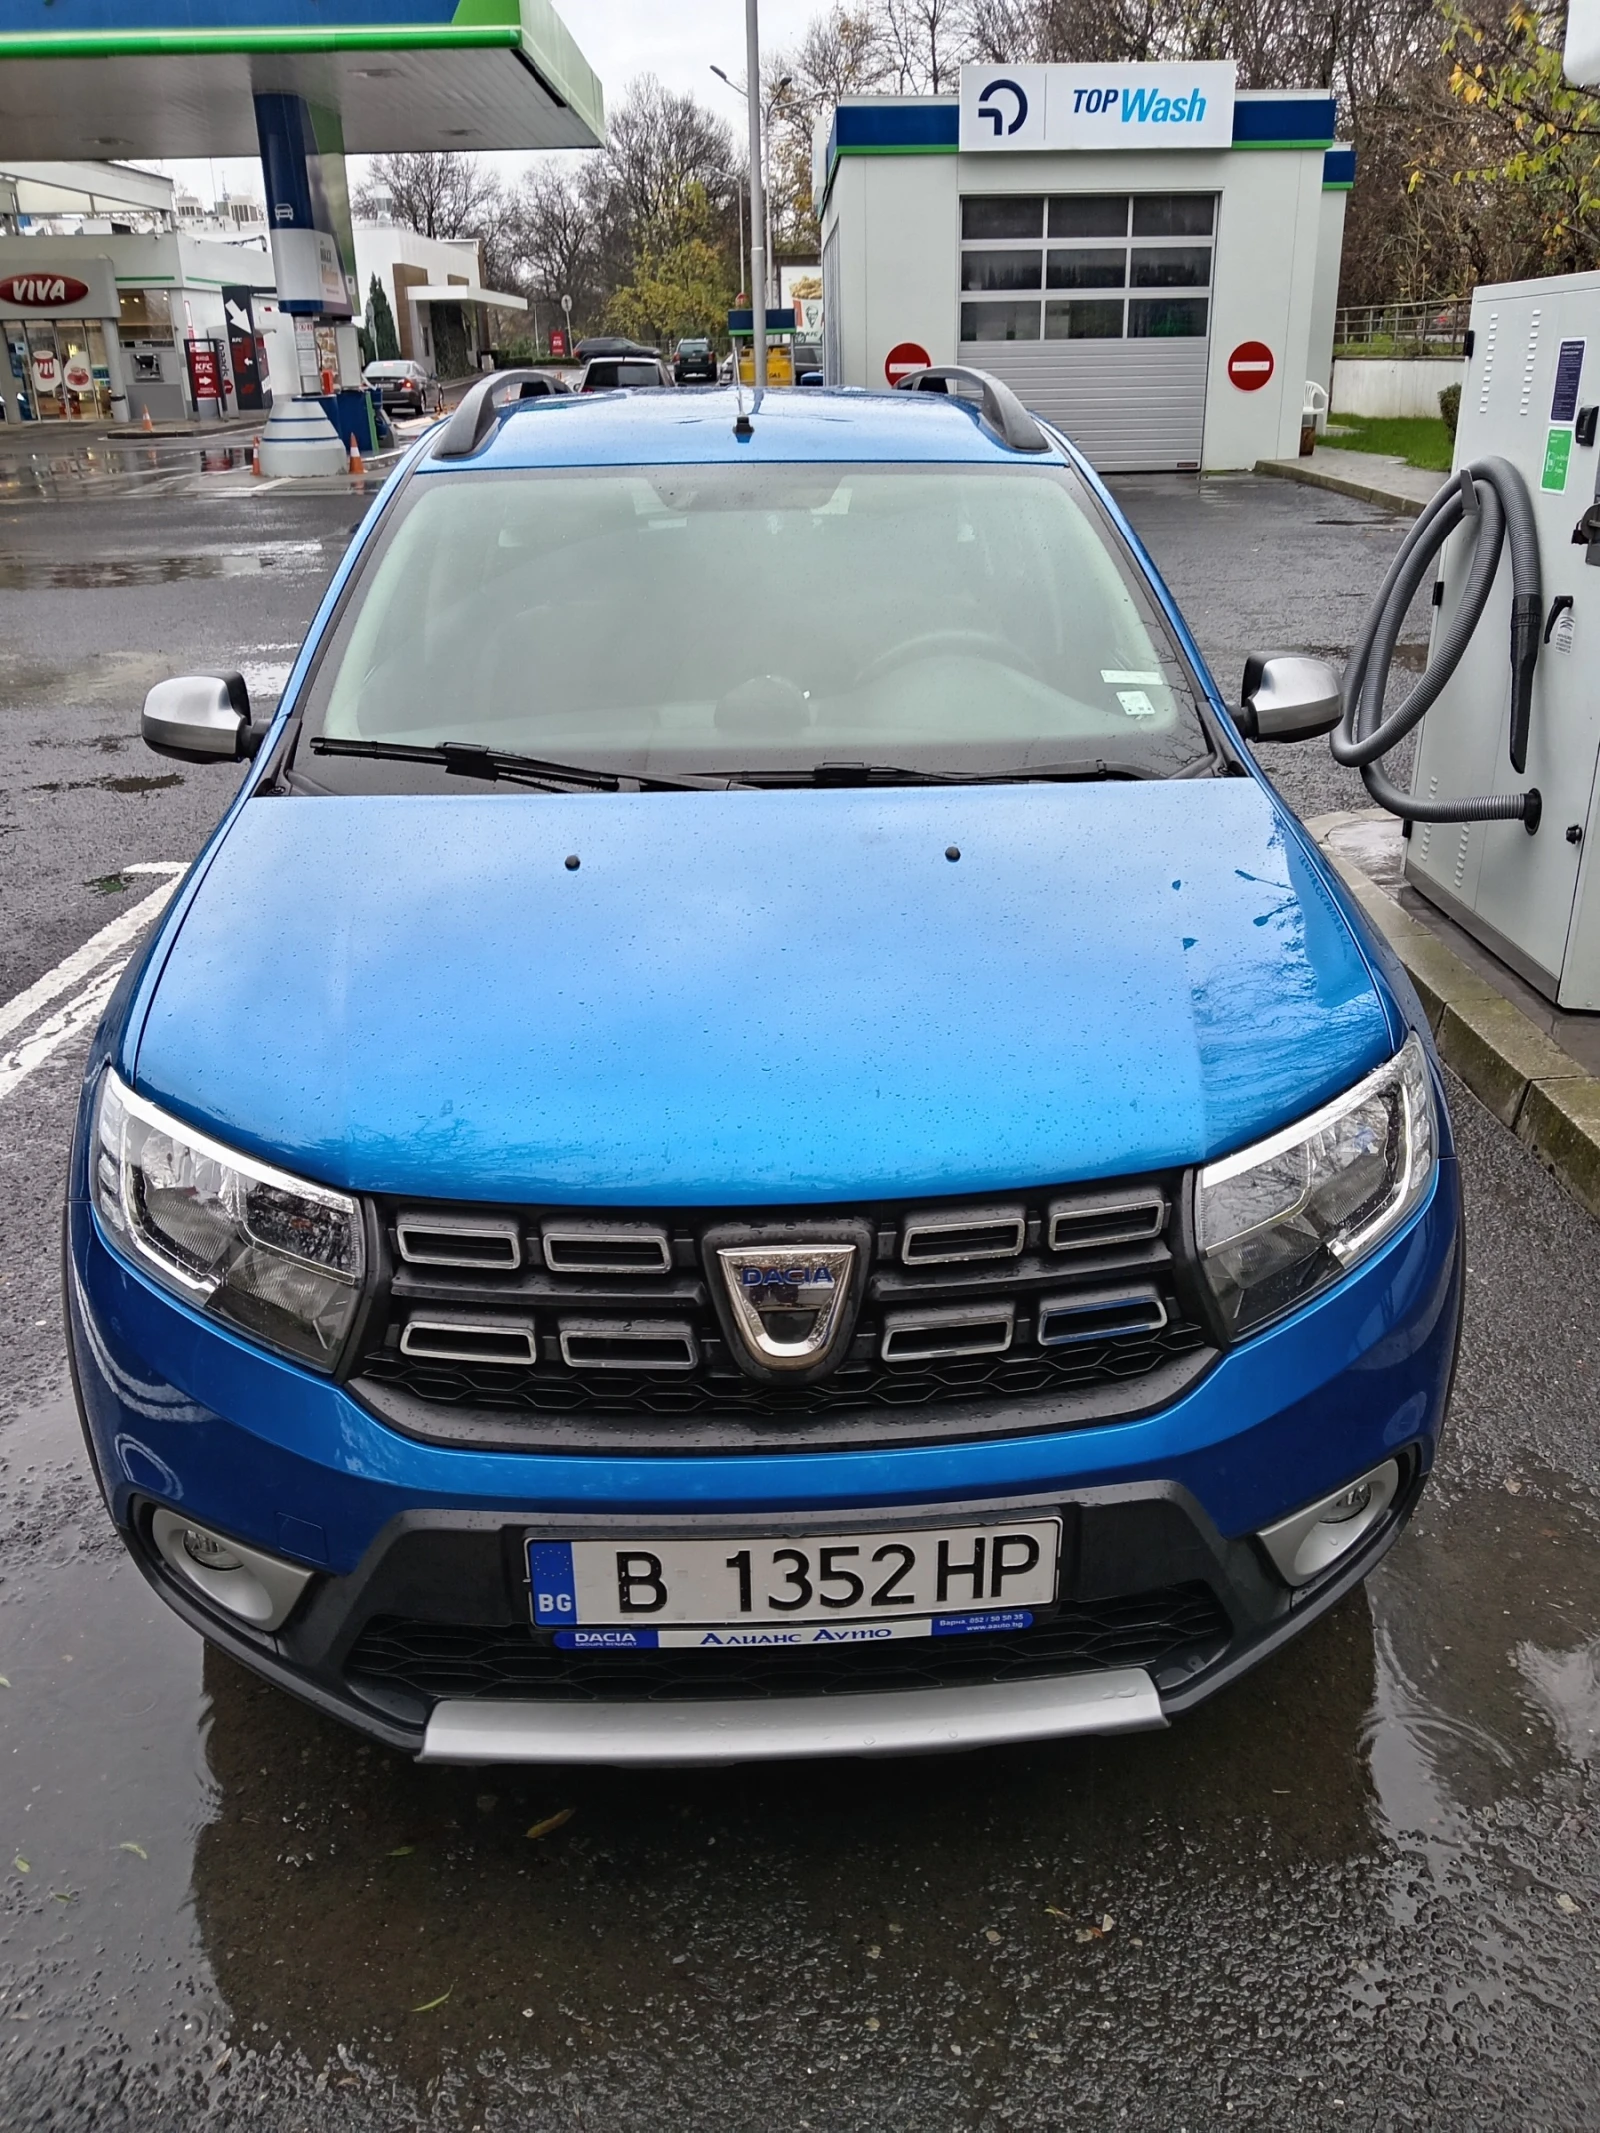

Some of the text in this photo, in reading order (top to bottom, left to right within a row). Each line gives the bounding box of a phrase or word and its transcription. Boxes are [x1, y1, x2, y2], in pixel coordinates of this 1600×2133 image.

[1073, 88, 1207, 123] TOP Wash
[12, 278, 66, 301] VIVA
[741, 1267, 834, 1286] DACIA
[615, 1533, 1041, 1614] B 1352 HP
[538, 1594, 572, 1613] BG
[575, 1633, 637, 1642] DACIA
